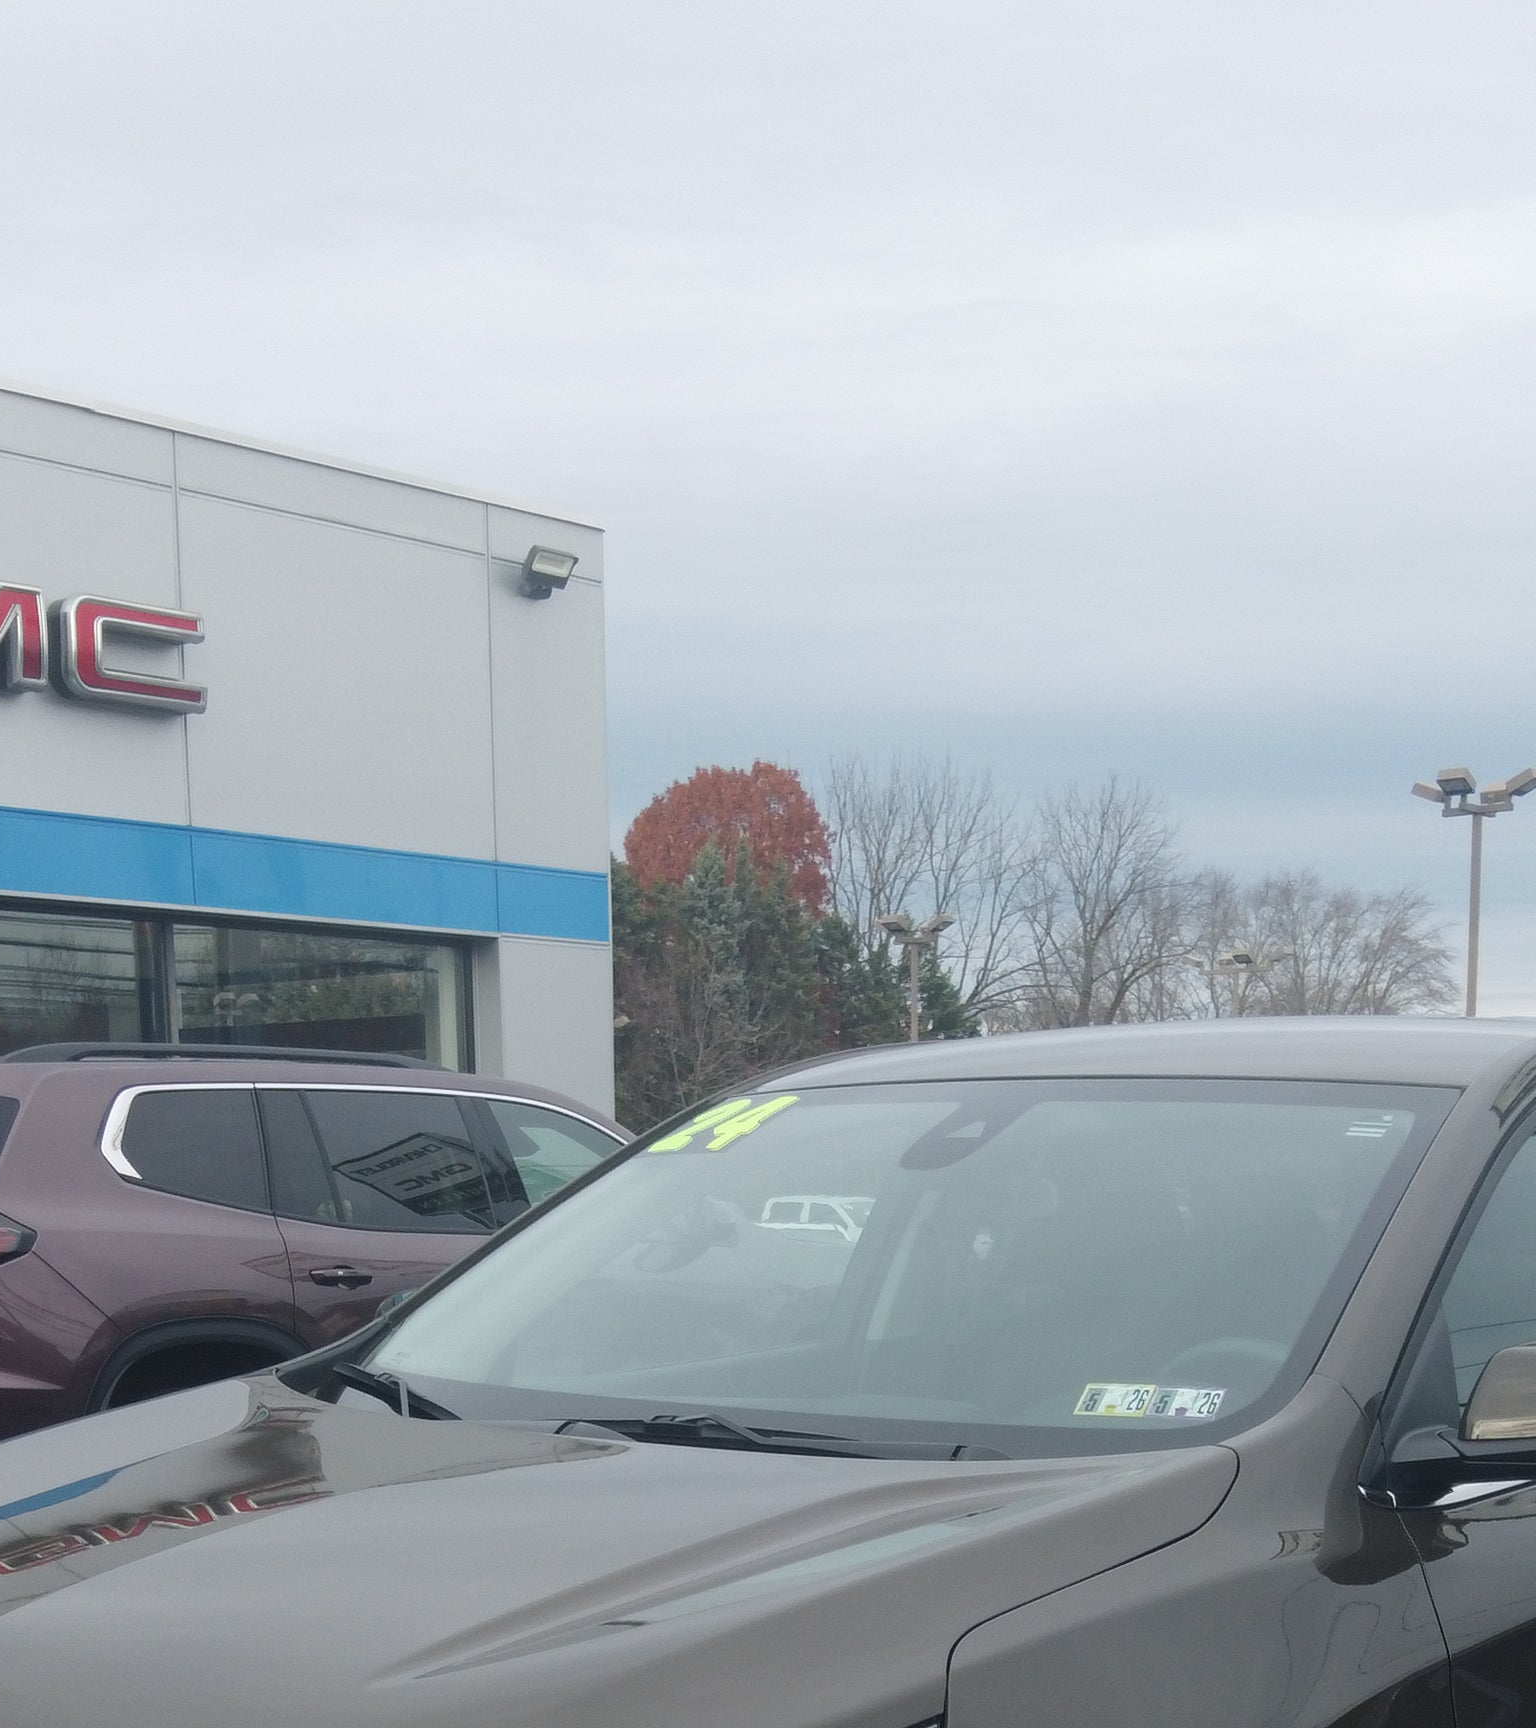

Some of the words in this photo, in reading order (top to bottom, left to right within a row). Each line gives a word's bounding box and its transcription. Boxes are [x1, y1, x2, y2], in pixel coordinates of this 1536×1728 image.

[648, 1096, 801, 1152] 24
[1084, 1393, 1101, 1412] 5
[1126, 1388, 1150, 1412] 26
[1154, 1394, 1171, 1414] 5
[1197, 1392, 1221, 1415] 26
